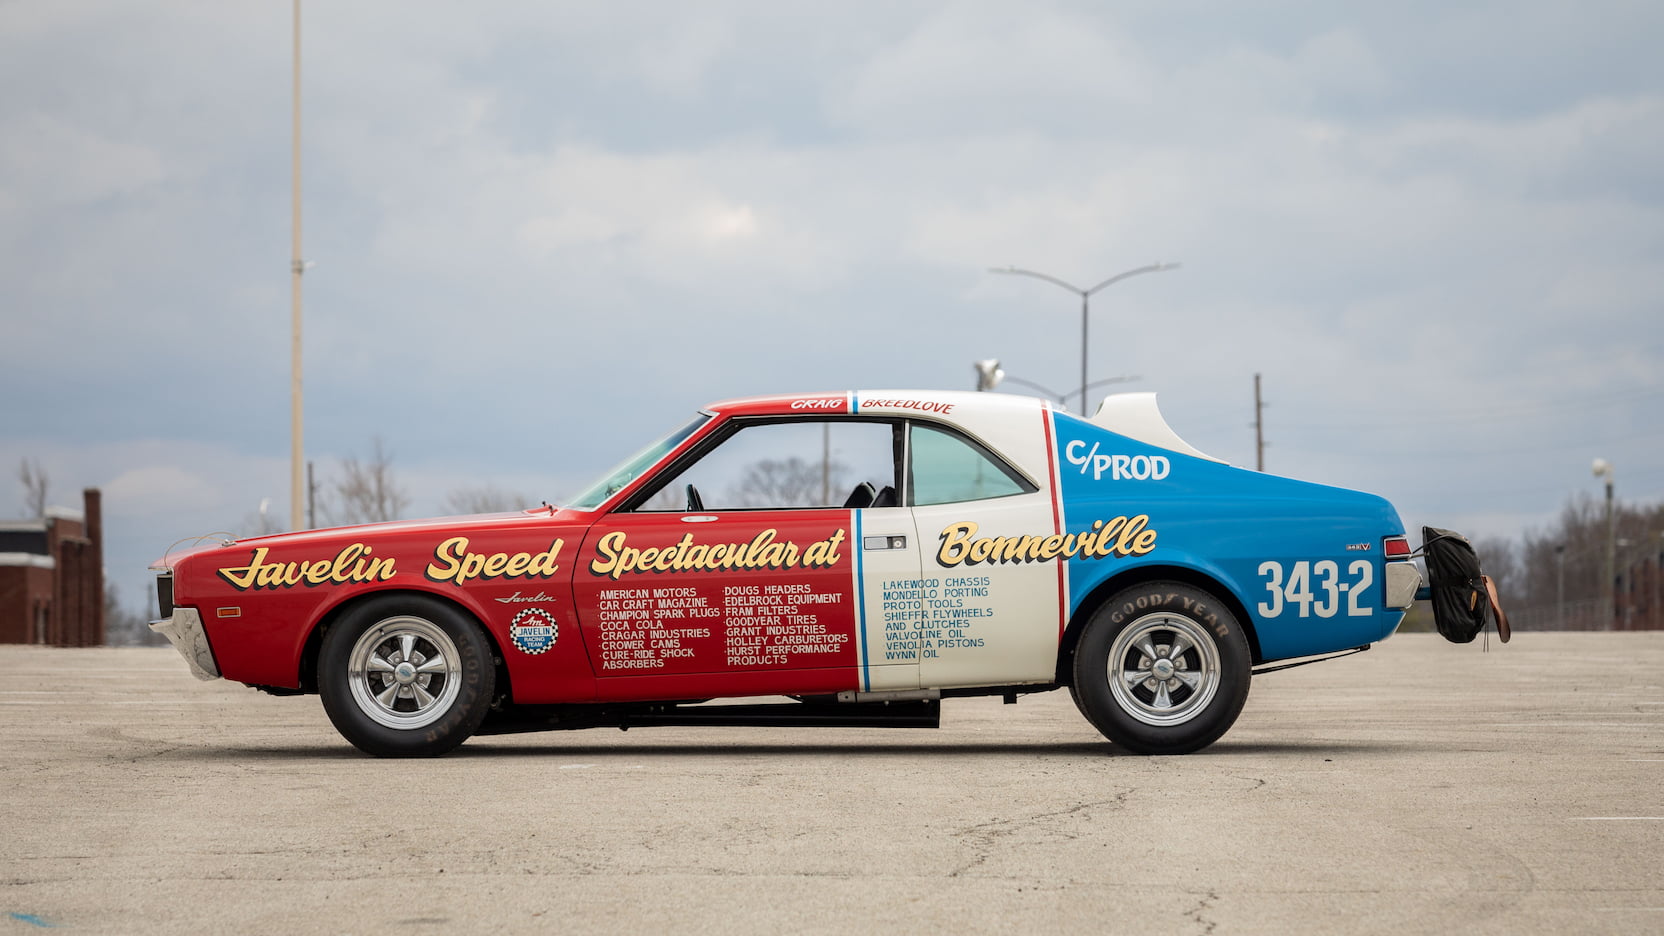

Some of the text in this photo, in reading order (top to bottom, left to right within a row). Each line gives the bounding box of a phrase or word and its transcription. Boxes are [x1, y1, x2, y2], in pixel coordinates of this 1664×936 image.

[790, 399, 957, 415] CRAIG BREEDLOVE
[216, 514, 1158, 591] Javelin Speed Spectacular at Bonneville
[883, 577, 990, 590] LAKEWOOD CHASSIS
[1257, 559, 1373, 619] 343-2
[600, 588, 697, 600] AMERICAN MOTORS
[725, 584, 811, 596] DOUGS HEADERS
[883, 587, 989, 600] MONDELLO PORTING
[494, 591, 557, 604] Javelin
[600, 597, 708, 610] CAR CRAFT MAGAZINE
[725, 593, 842, 606] EDELBROCK EQUIPMENT
[883, 599, 963, 610] PROTO TOOLS
[600, 608, 720, 620] CHAMPION SPARK PLUGS
[725, 606, 798, 616] FRAM FILTERS
[934, 608, 994, 618] FLYWHEELS
[600, 620, 664, 631] COCA COLA
[726, 615, 817, 627] GOODYEAR TIRES
[886, 620, 970, 631] AND CLUTCHES
[519, 627, 551, 636] JAVELIN
[601, 628, 710, 640] CRAGAR INDUSTRIES
[726, 625, 826, 637] GRANT INDUSTRIES
[886, 629, 965, 641] VALVOLINE OIL
[601, 639, 680, 650] CROWER CAMS
[727, 634, 848, 646] HOLLEY CARBURETORS
[886, 639, 985, 650] VENOLIA PISTONS
[602, 648, 695, 660] CURE-RIDE SHOCK
[727, 644, 841, 655] HURST PERFORMANCE
[886, 650, 939, 659] WYNN OIL
[603, 659, 664, 670] ABSORBERS
[727, 655, 788, 666] PRODUCTS
